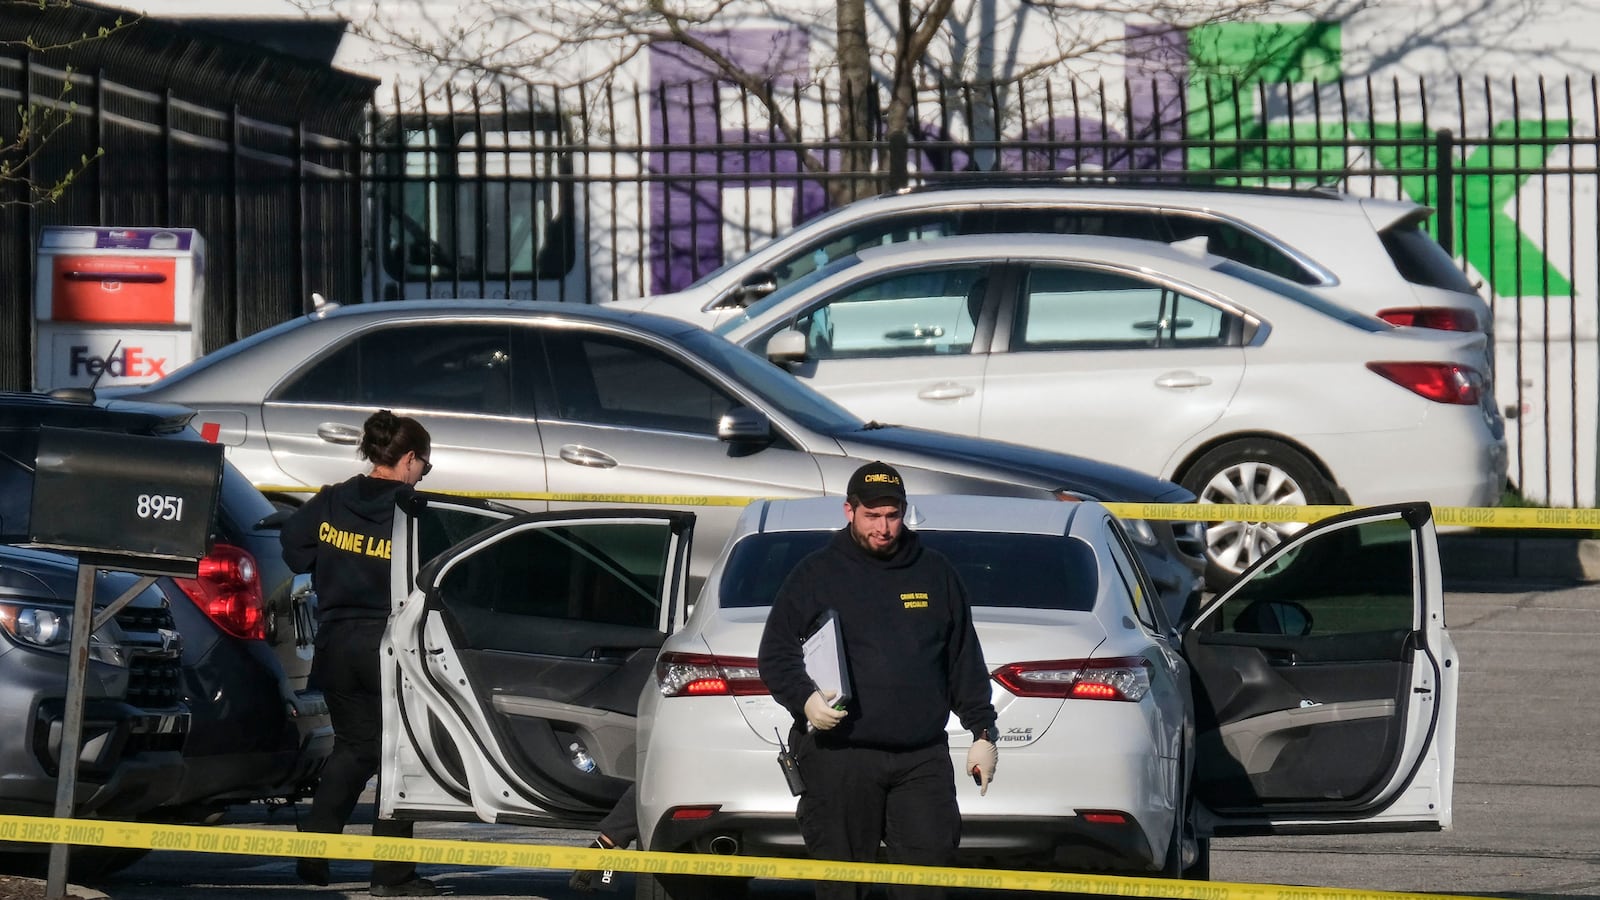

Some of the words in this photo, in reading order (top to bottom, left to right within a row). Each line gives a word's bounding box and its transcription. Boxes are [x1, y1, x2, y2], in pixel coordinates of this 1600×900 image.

[70, 346, 167, 379] FedEx
[865, 473, 888, 483] CRIME
[137, 494, 183, 521] 8951
[319, 521, 365, 554] CRIME
